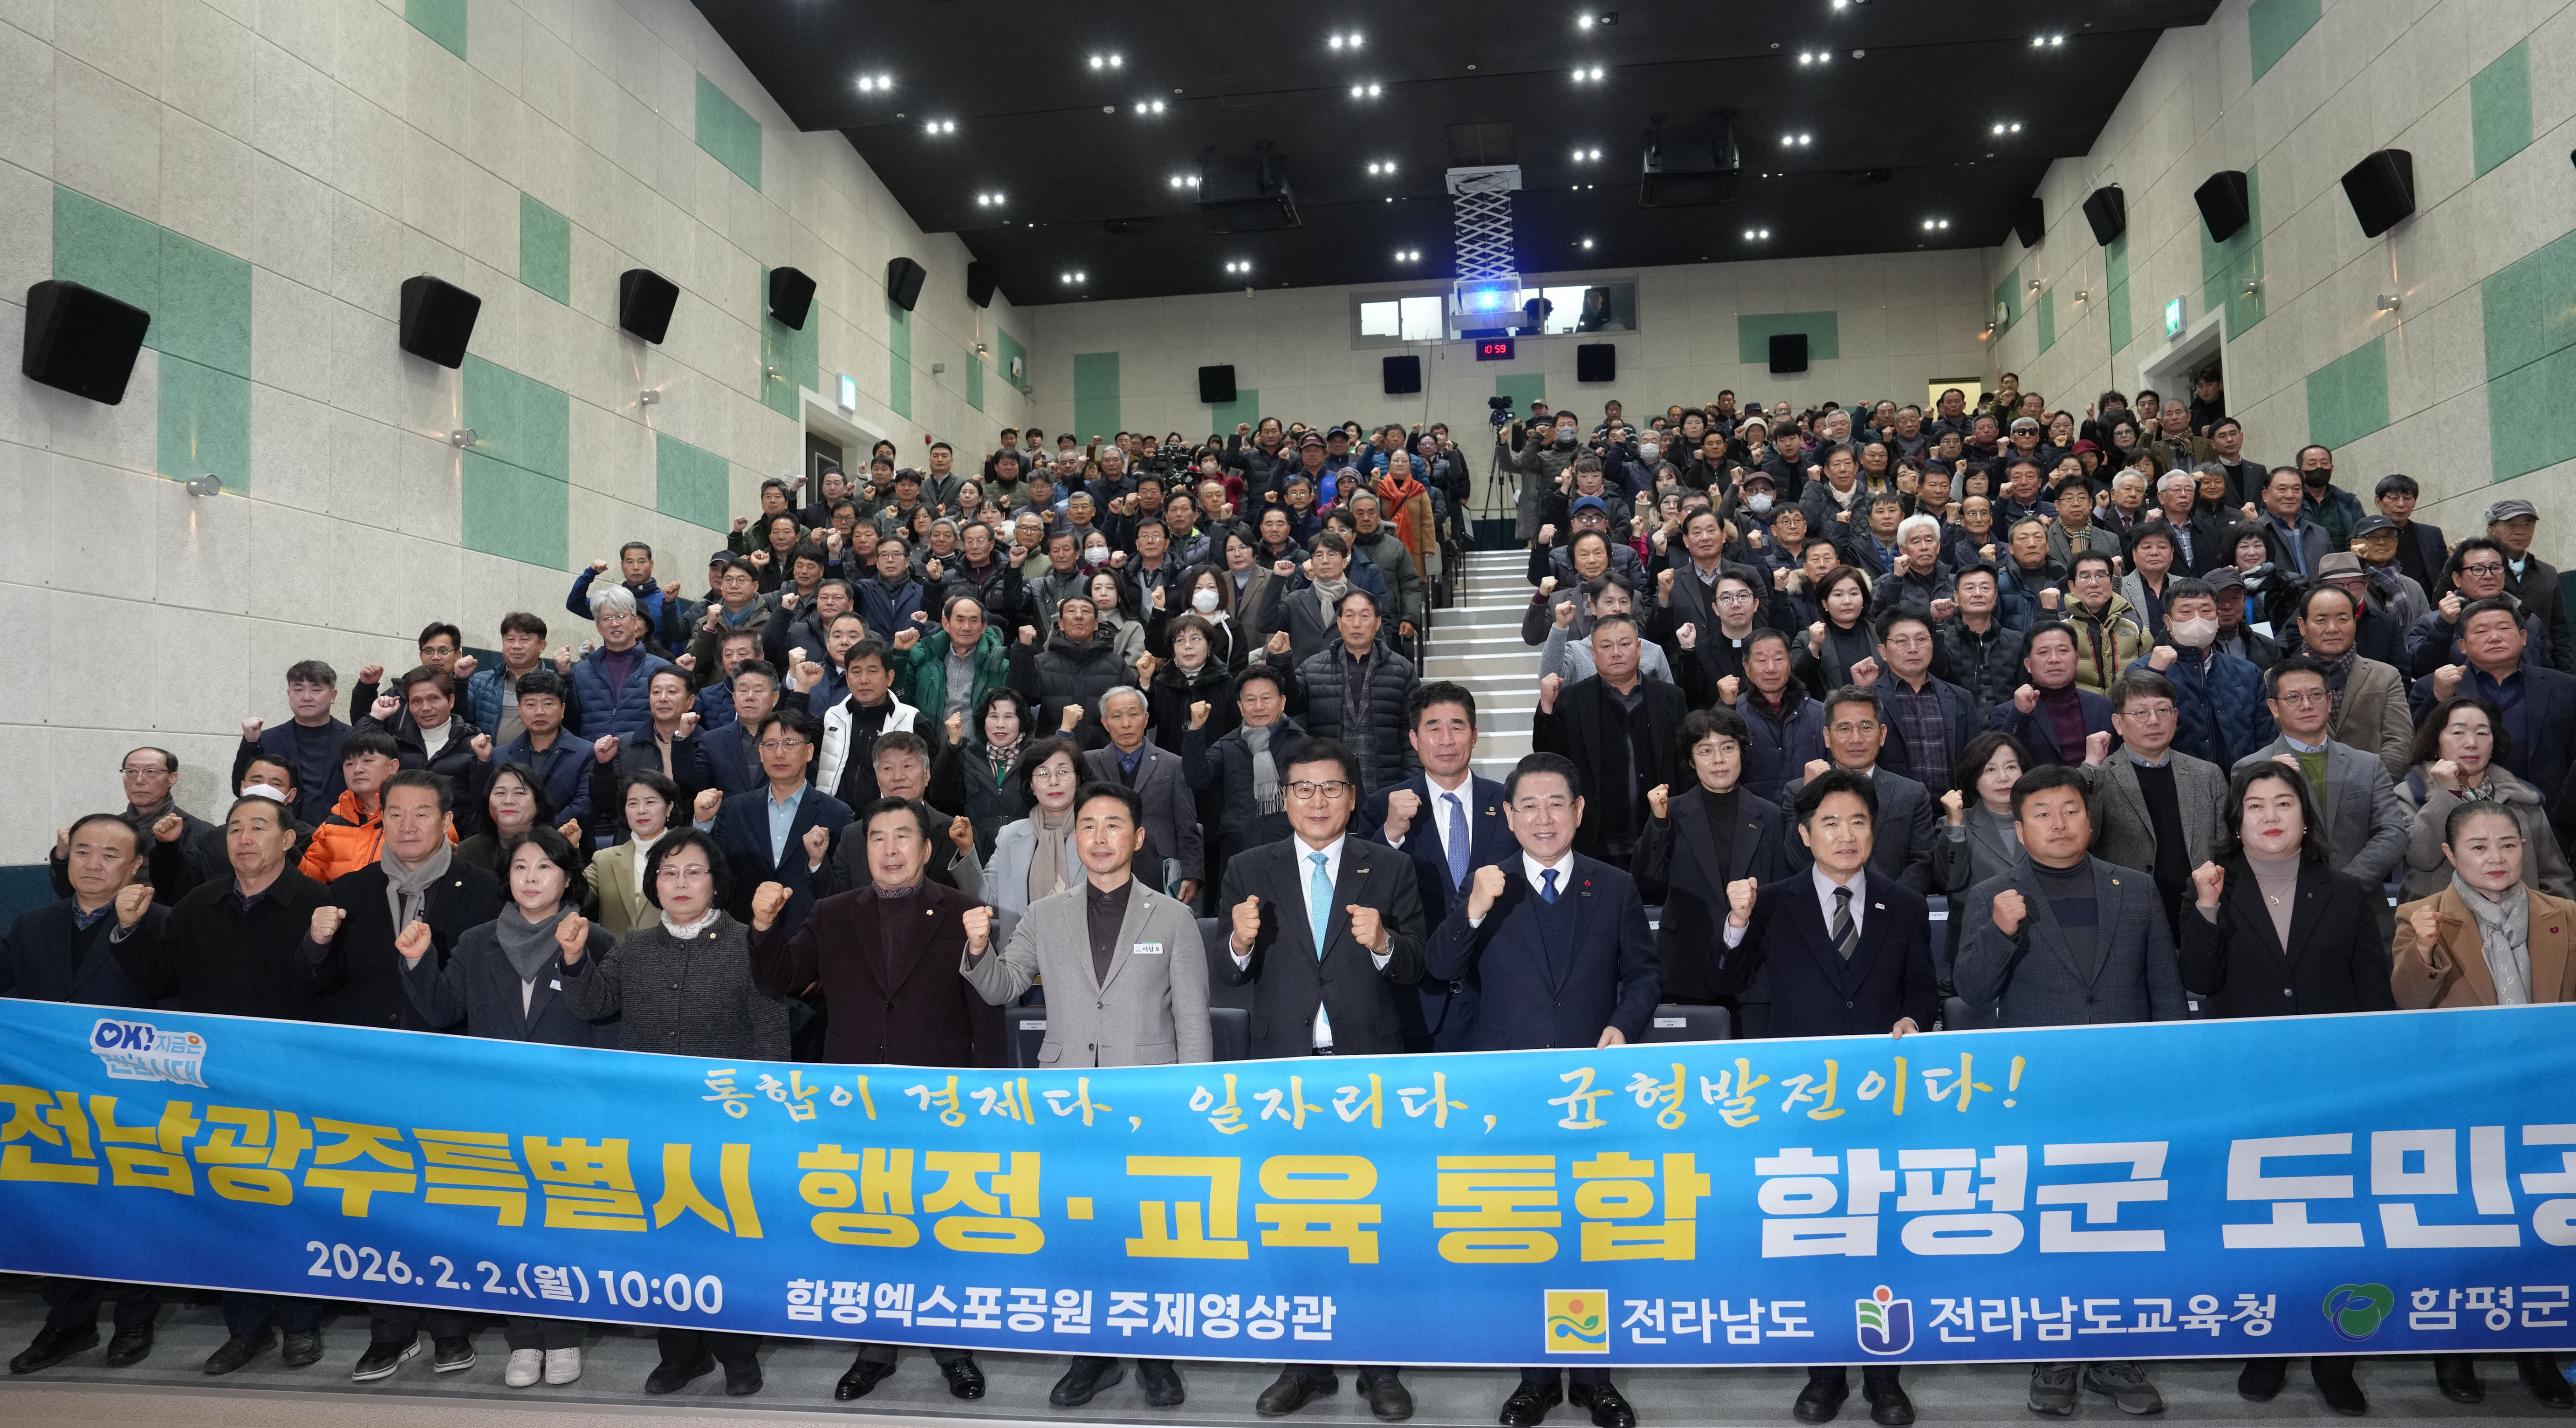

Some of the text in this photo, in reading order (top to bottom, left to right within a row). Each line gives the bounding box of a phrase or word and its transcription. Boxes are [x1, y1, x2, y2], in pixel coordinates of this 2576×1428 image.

[1484, 344, 1507, 354] 10:59
[95, 1022, 155, 1052] OK!
[155, 1035, 202, 1055] 지금은
[701, 1052, 2026, 1135] 통합이 경제다, 일자리다, 균형발전이다!
[0, 1084, 764, 1239] 전남광주특별시
[1432, 1151, 1711, 1264] 통합
[1754, 1141, 2169, 1258] 함평군
[598, 1269, 723, 1314] 10:00
[786, 1278, 1336, 1341] 함평엑스포공원 주제영상관
[2409, 1285, 2570, 1332] 함평군
[1621, 1297, 1815, 1345] 전라남도
[1929, 1293, 2277, 1343] 전라남도교육청
